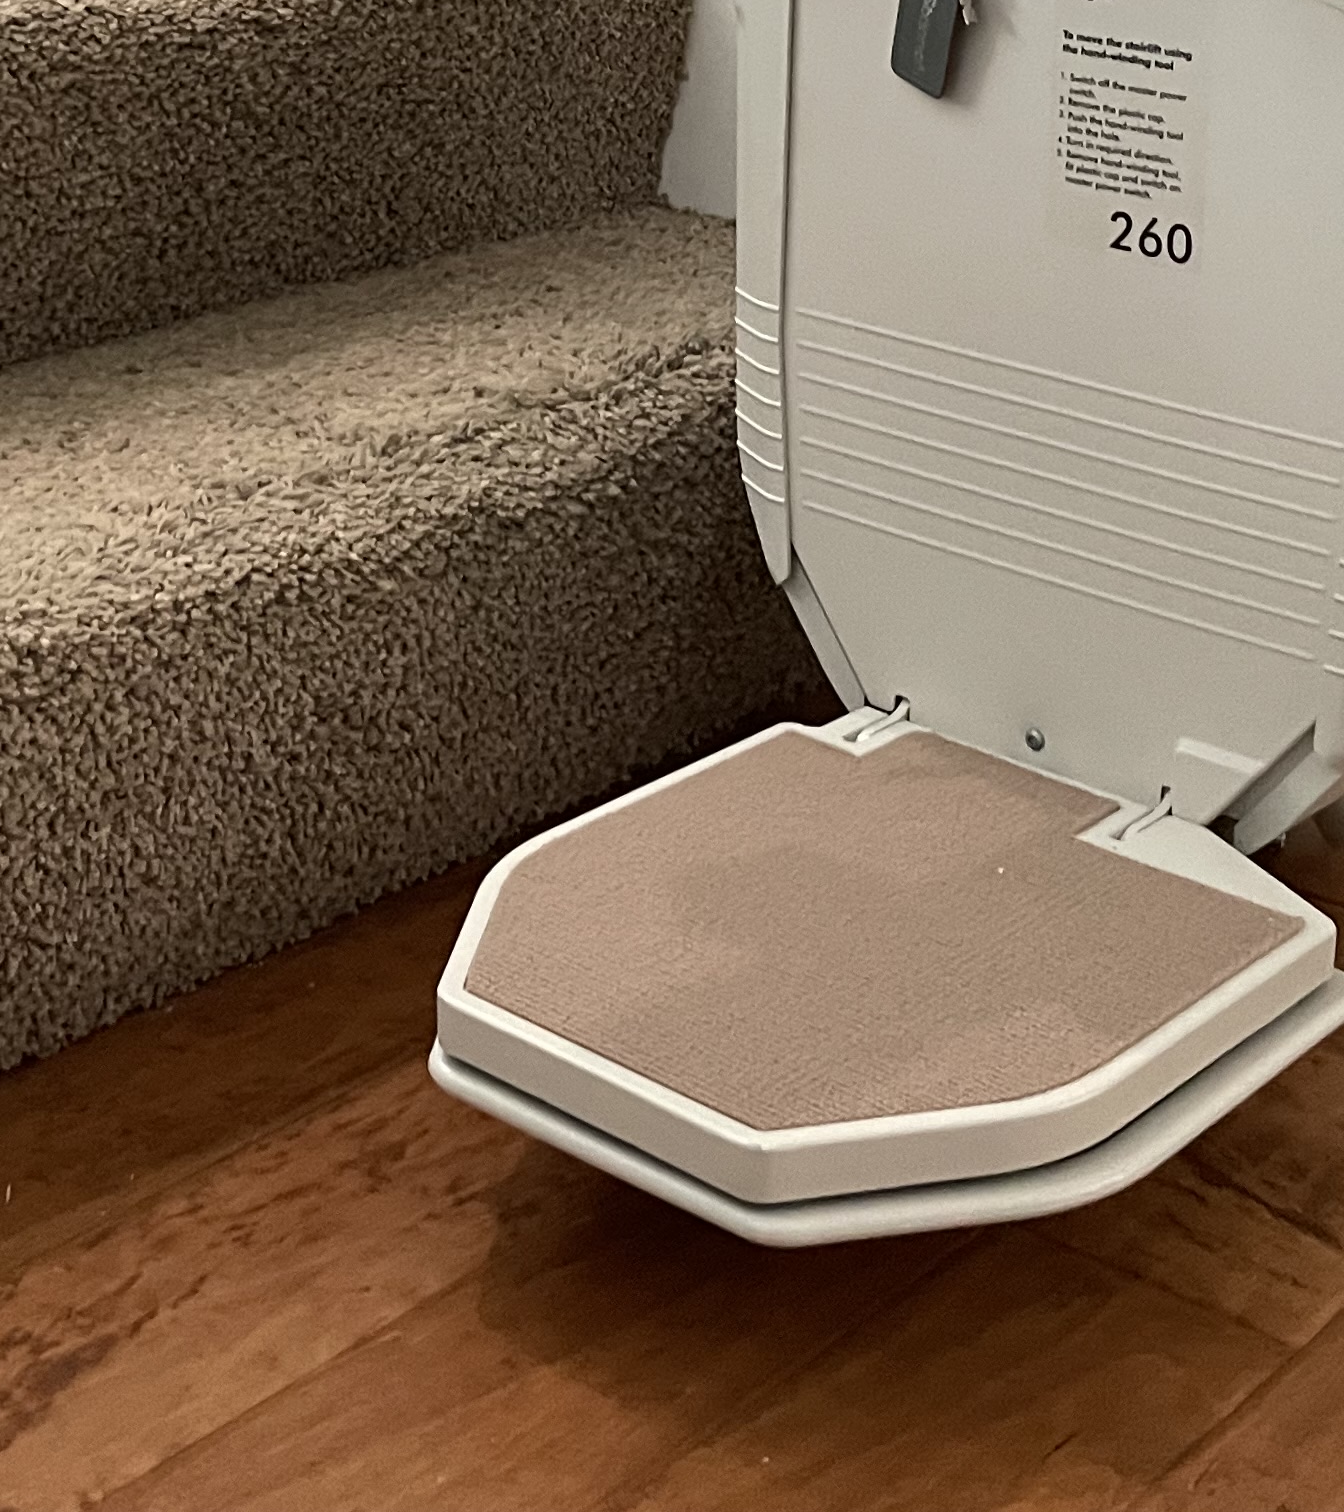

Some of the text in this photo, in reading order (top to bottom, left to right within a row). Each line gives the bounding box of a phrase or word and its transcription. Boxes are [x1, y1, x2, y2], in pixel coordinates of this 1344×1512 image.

[1063, 29, 1074, 39] To
[1077, 34, 1102, 45] move
[1107, 38, 1122, 48] the
[1164, 48, 1192, 61] using
[1063, 44, 1173, 70] the hand-winding tool
[1109, 211, 1193, 264] 260
